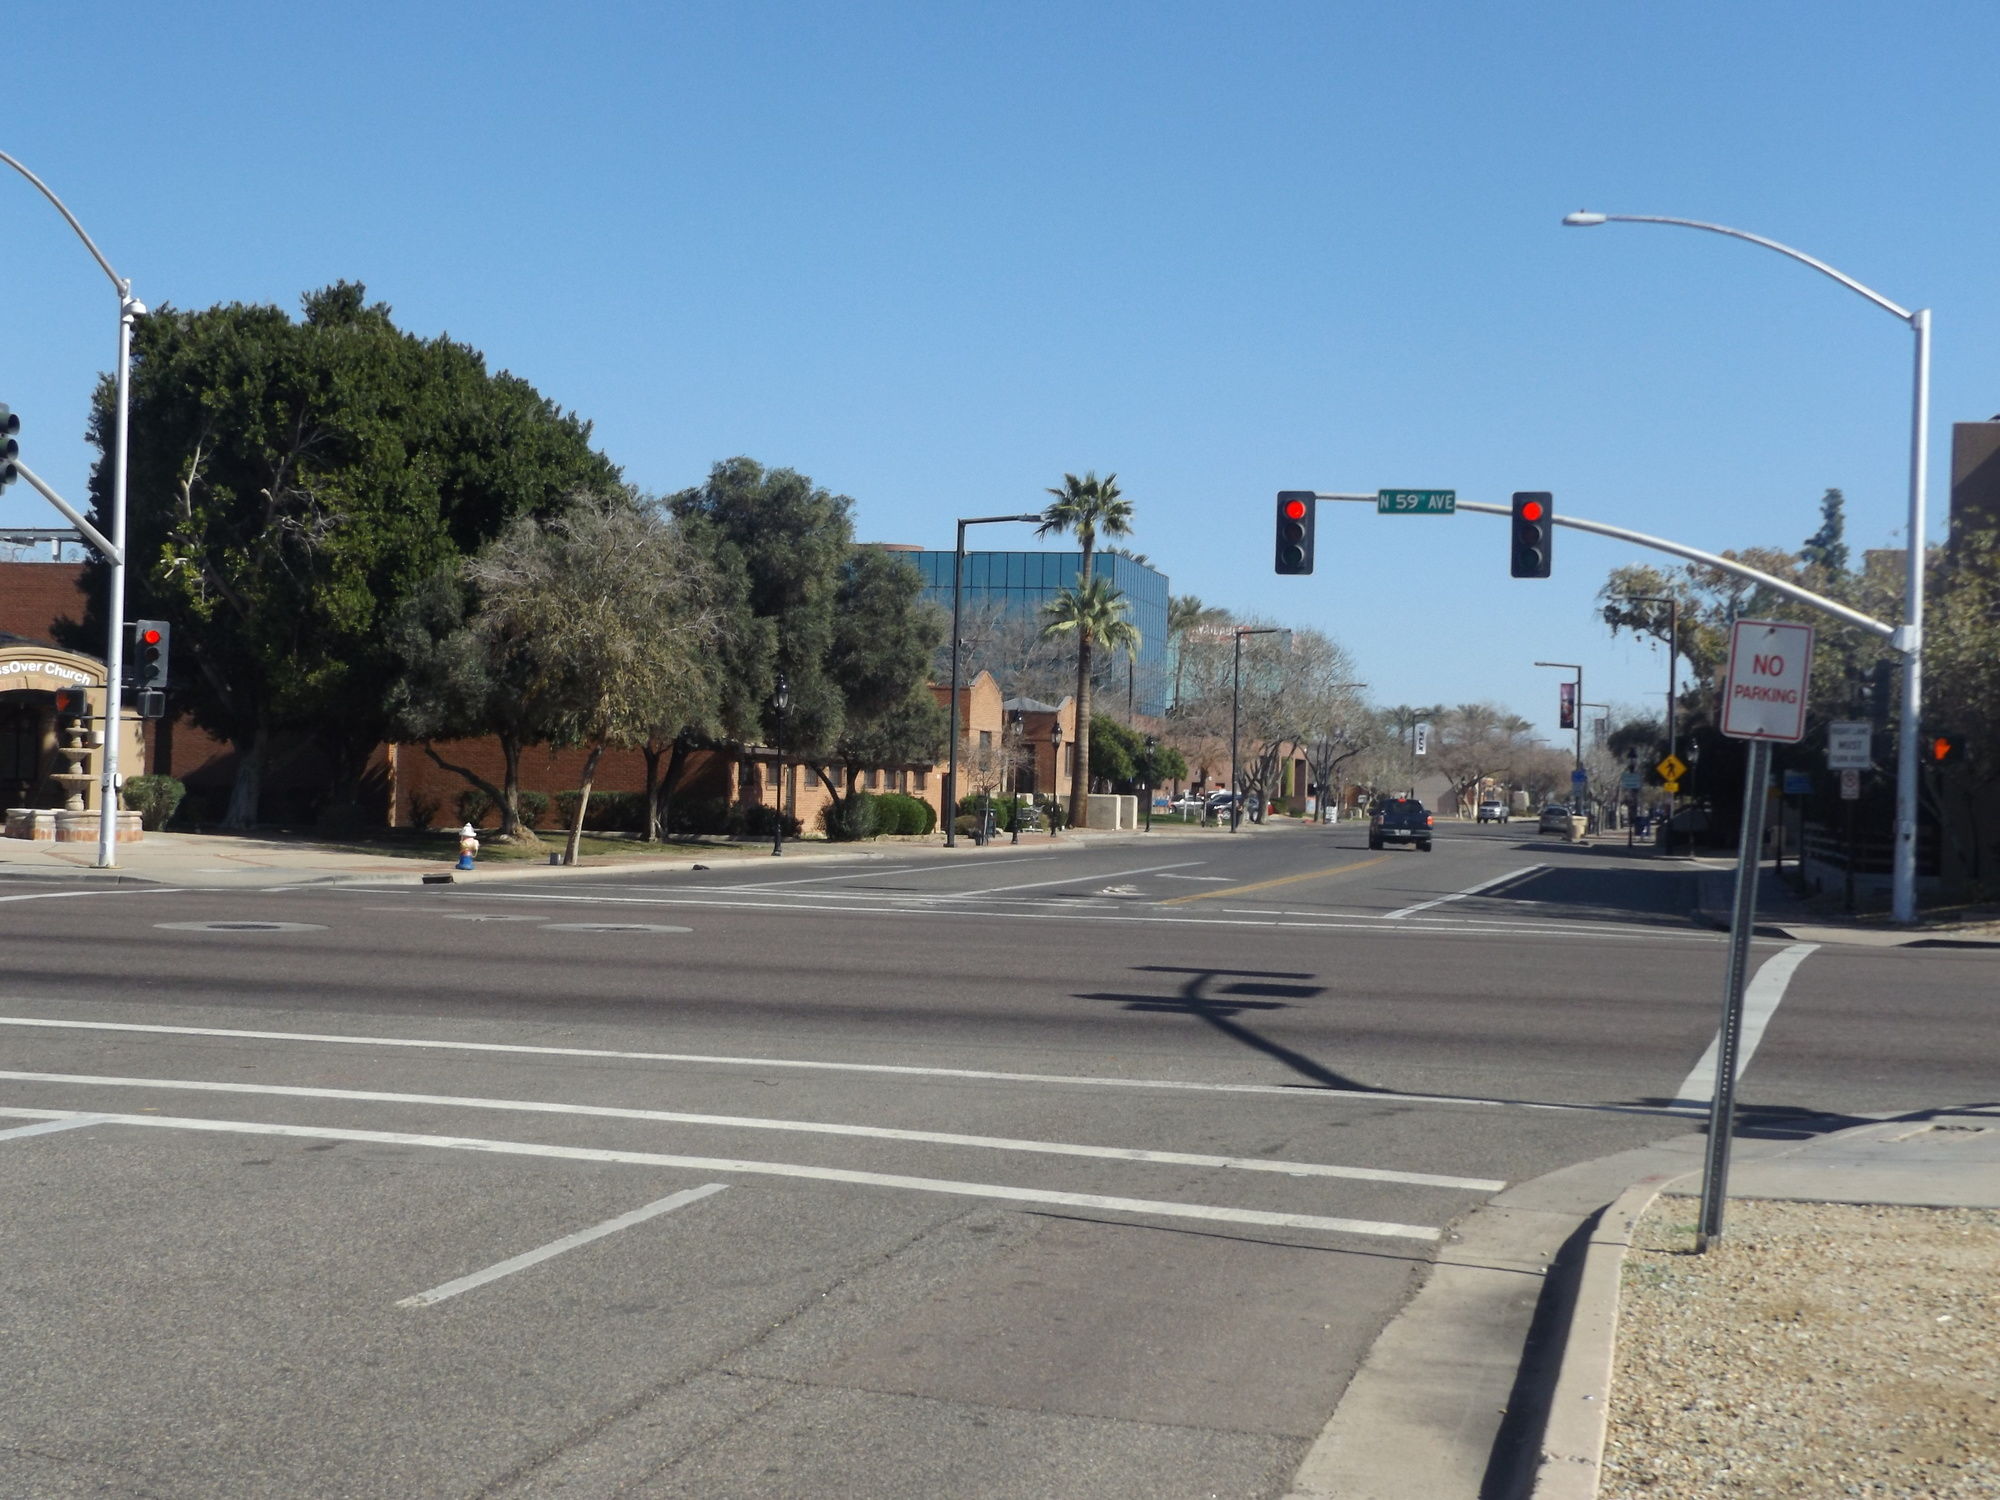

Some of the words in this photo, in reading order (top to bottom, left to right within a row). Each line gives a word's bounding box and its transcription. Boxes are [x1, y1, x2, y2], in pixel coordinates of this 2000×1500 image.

[1380, 494, 1389, 508] N
[1428, 494, 1453, 509] AVE
[0, 661, 43, 675] sOver
[45, 663, 91, 685] Church
[1753, 654, 1785, 676] NO
[1735, 685, 1798, 704] PARKING
[1839, 740, 1862, 750] MUST
